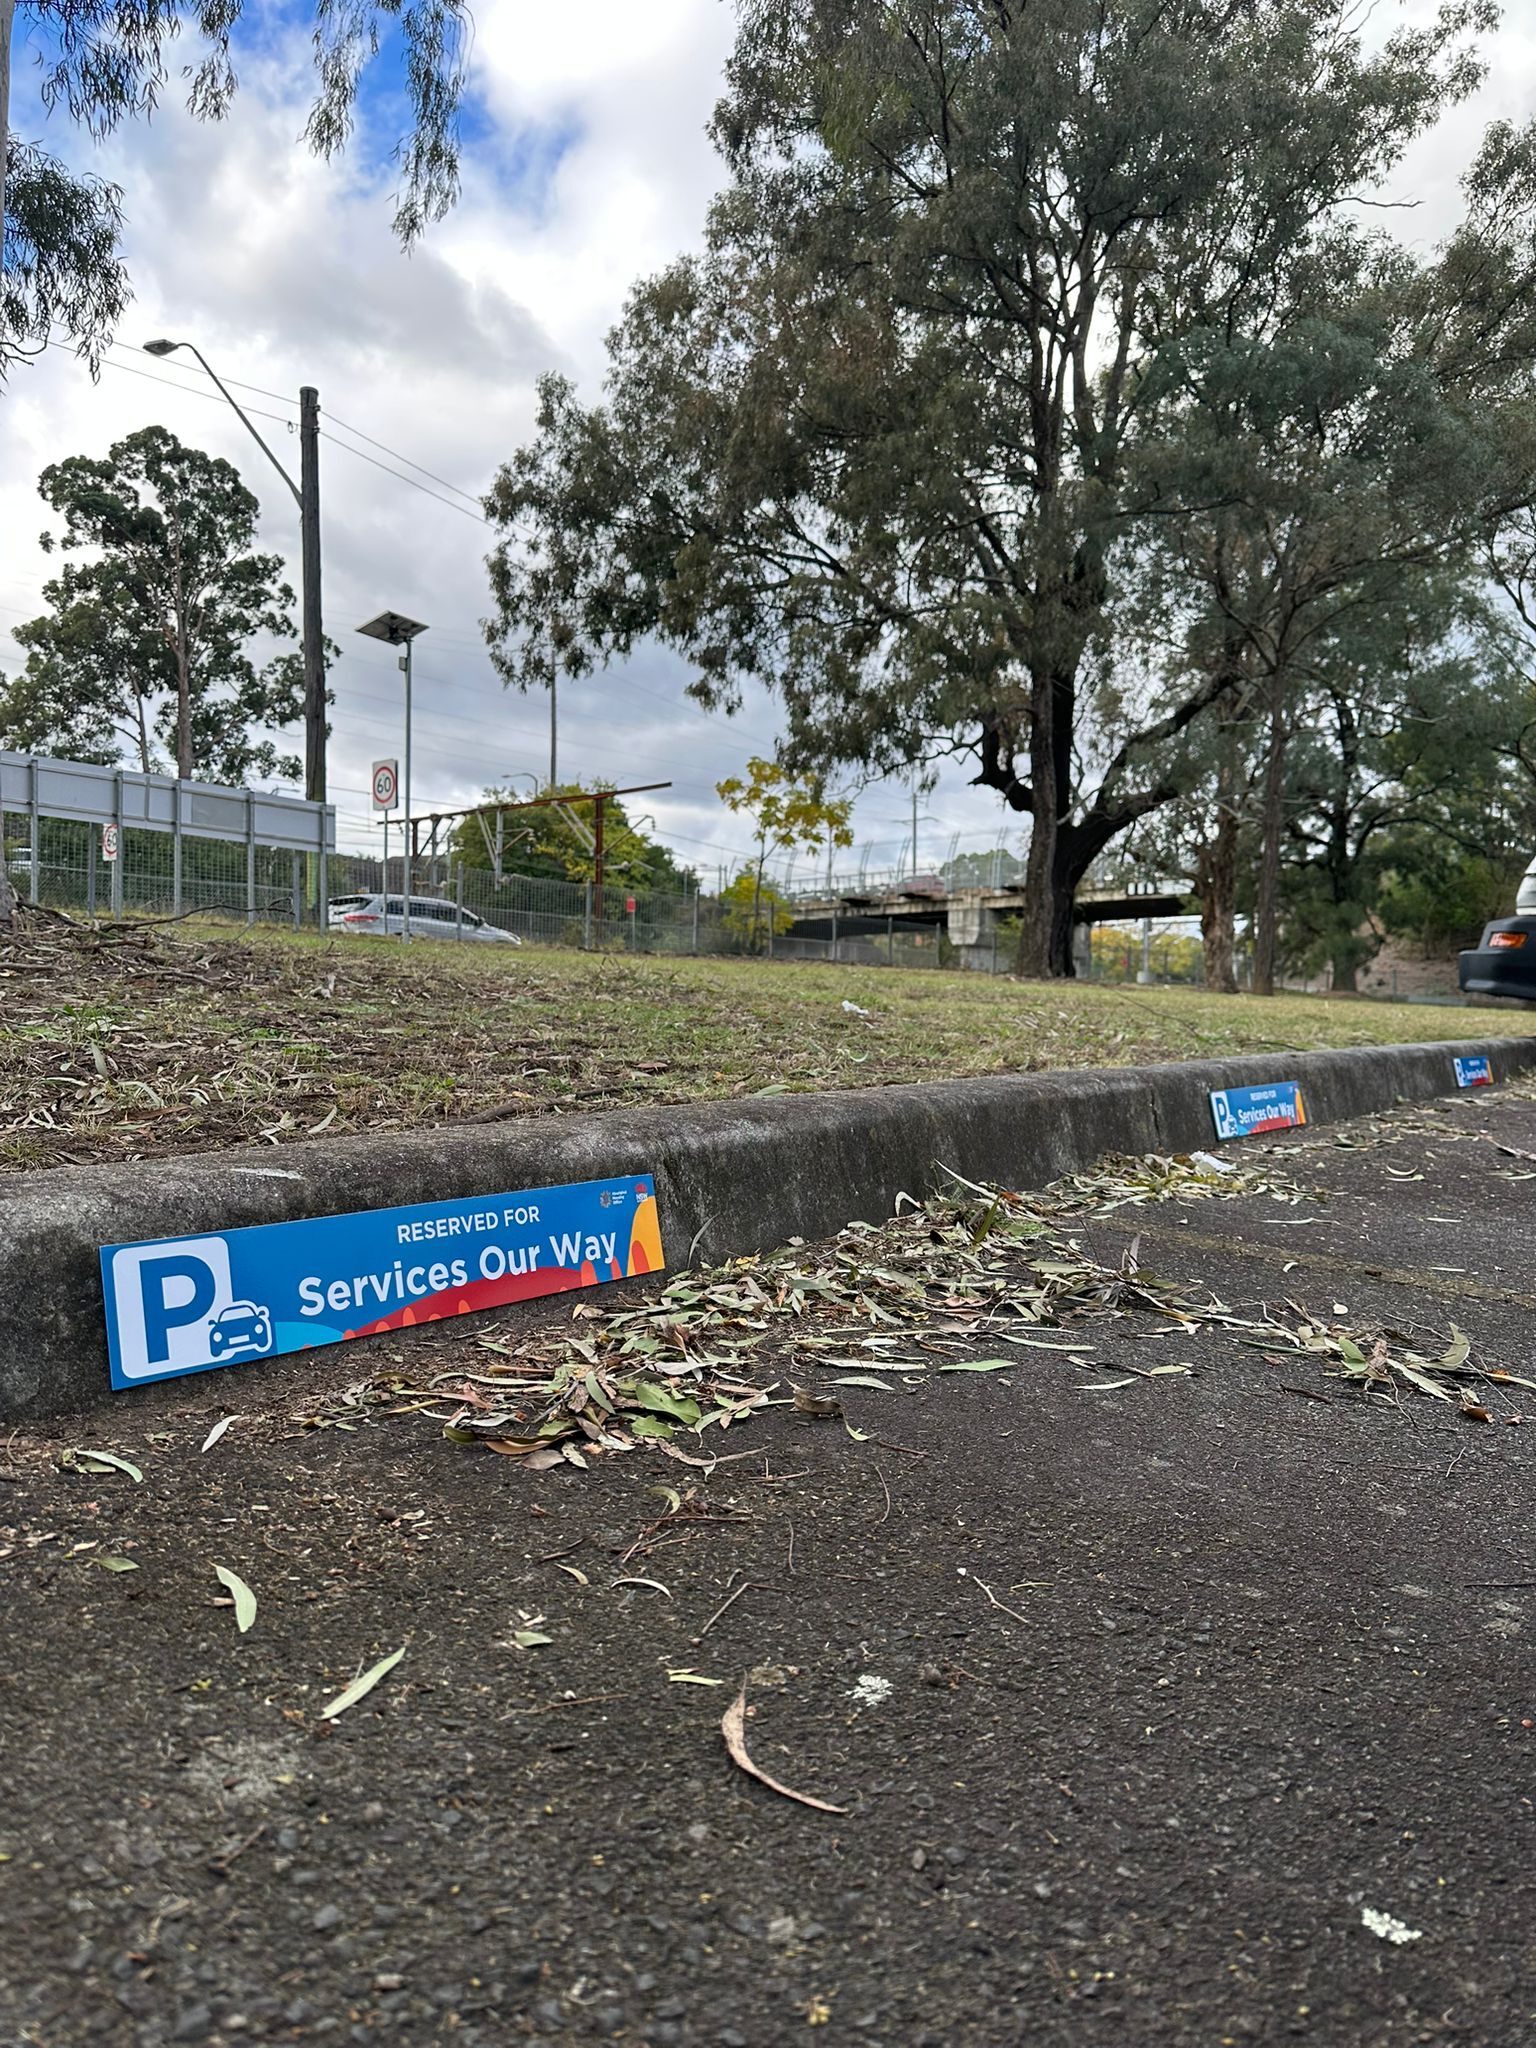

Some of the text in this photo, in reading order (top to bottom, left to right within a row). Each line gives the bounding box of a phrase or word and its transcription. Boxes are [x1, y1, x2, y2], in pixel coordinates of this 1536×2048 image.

[377, 776, 391, 794] 60
[1238, 1102, 1295, 1124] Services Our Way
[397, 1205, 540, 1244] RESERVED FOR
[298, 1230, 617, 1317] Services Our Way
[139, 1254, 216, 1364] P
